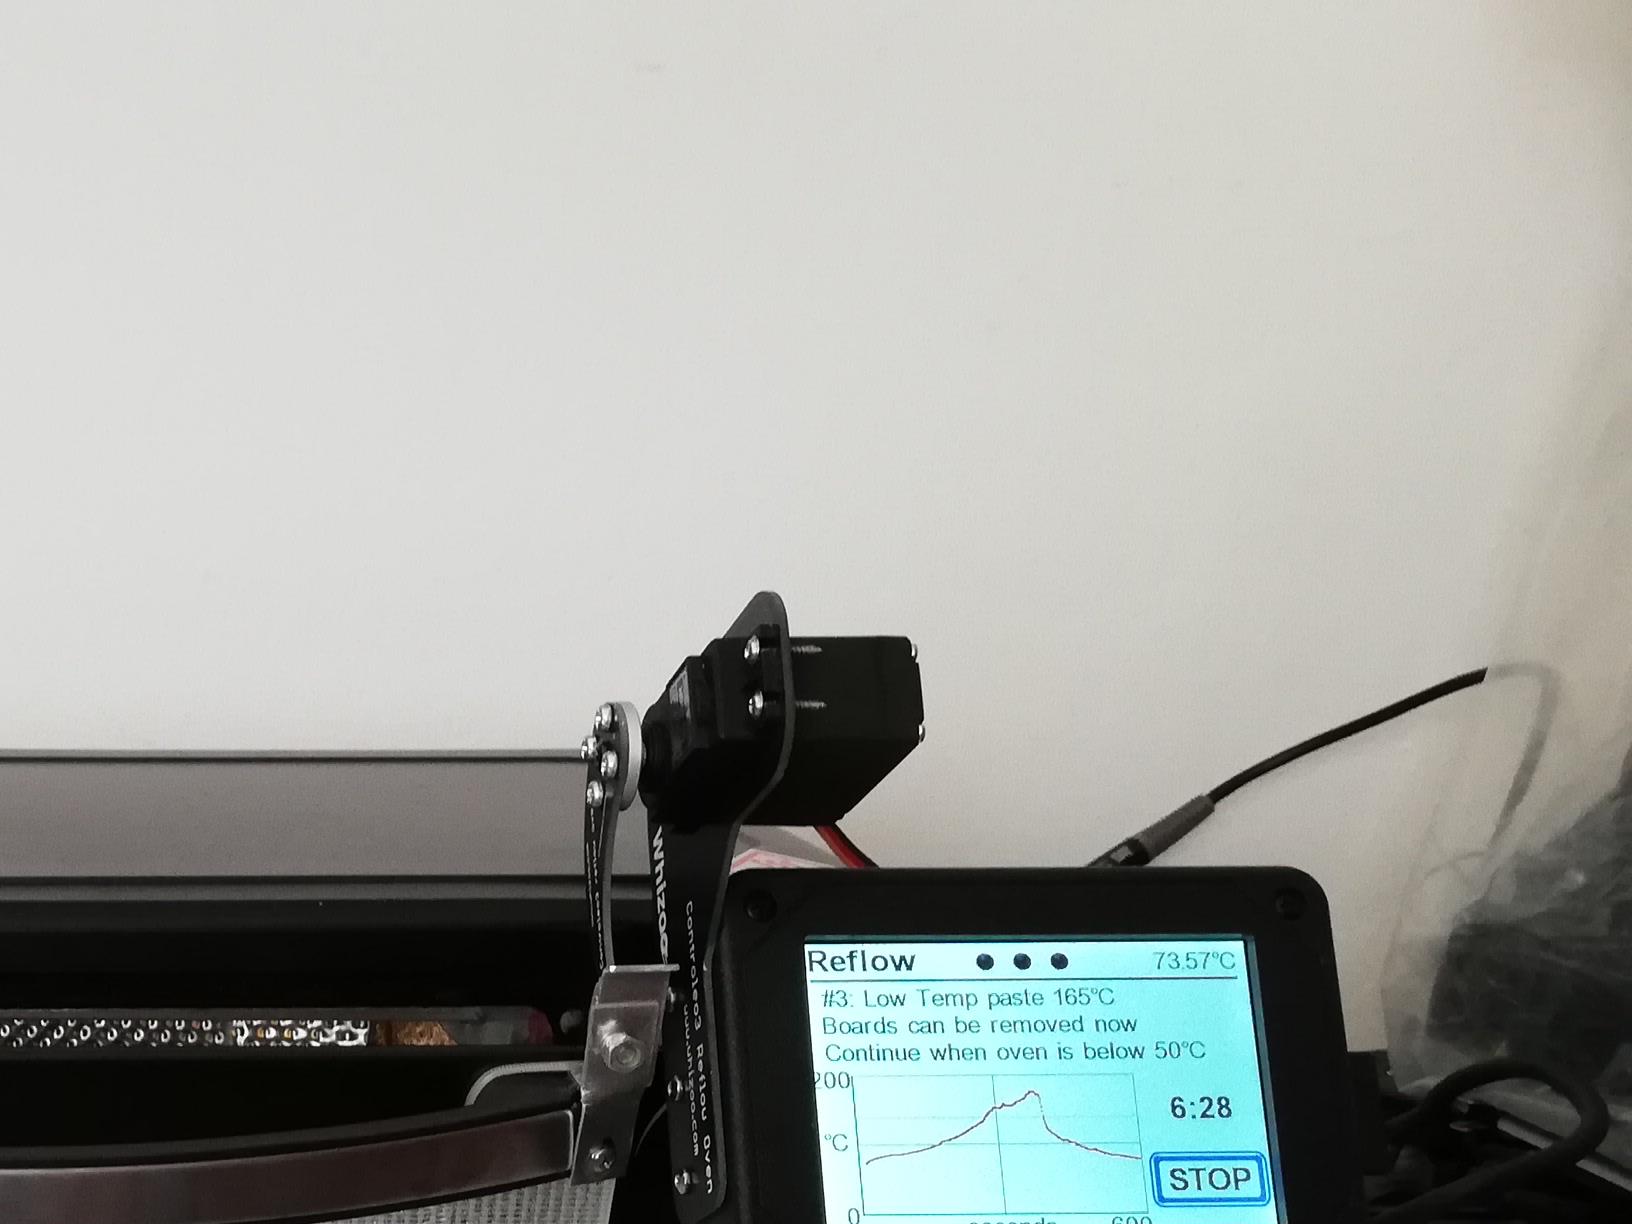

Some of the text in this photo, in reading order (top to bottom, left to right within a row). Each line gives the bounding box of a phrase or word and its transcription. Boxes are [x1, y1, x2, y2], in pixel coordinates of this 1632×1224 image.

[808, 950, 915, 972] Reflow
[822, 989, 855, 1008] #3:
[864, 989, 907, 1008] Low
[916, 988, 978, 1010] Temp
[988, 988, 1044, 1010] paste
[822, 1015, 1138, 1035] Boards can be removed now
[686, 900, 702, 1031] Controleo3
[703, 1134, 713, 1194] Oven
[825, 1043, 920, 1062] Continue
[930, 1043, 987, 1061] when
[997, 1045, 1048, 1060] oven
[1057, 1041, 1074, 1060] is
[1083, 1041, 1145, 1060] below
[1170, 1096, 1233, 1119] 6:28
[1169, 1167, 1252, 1191] STOP
